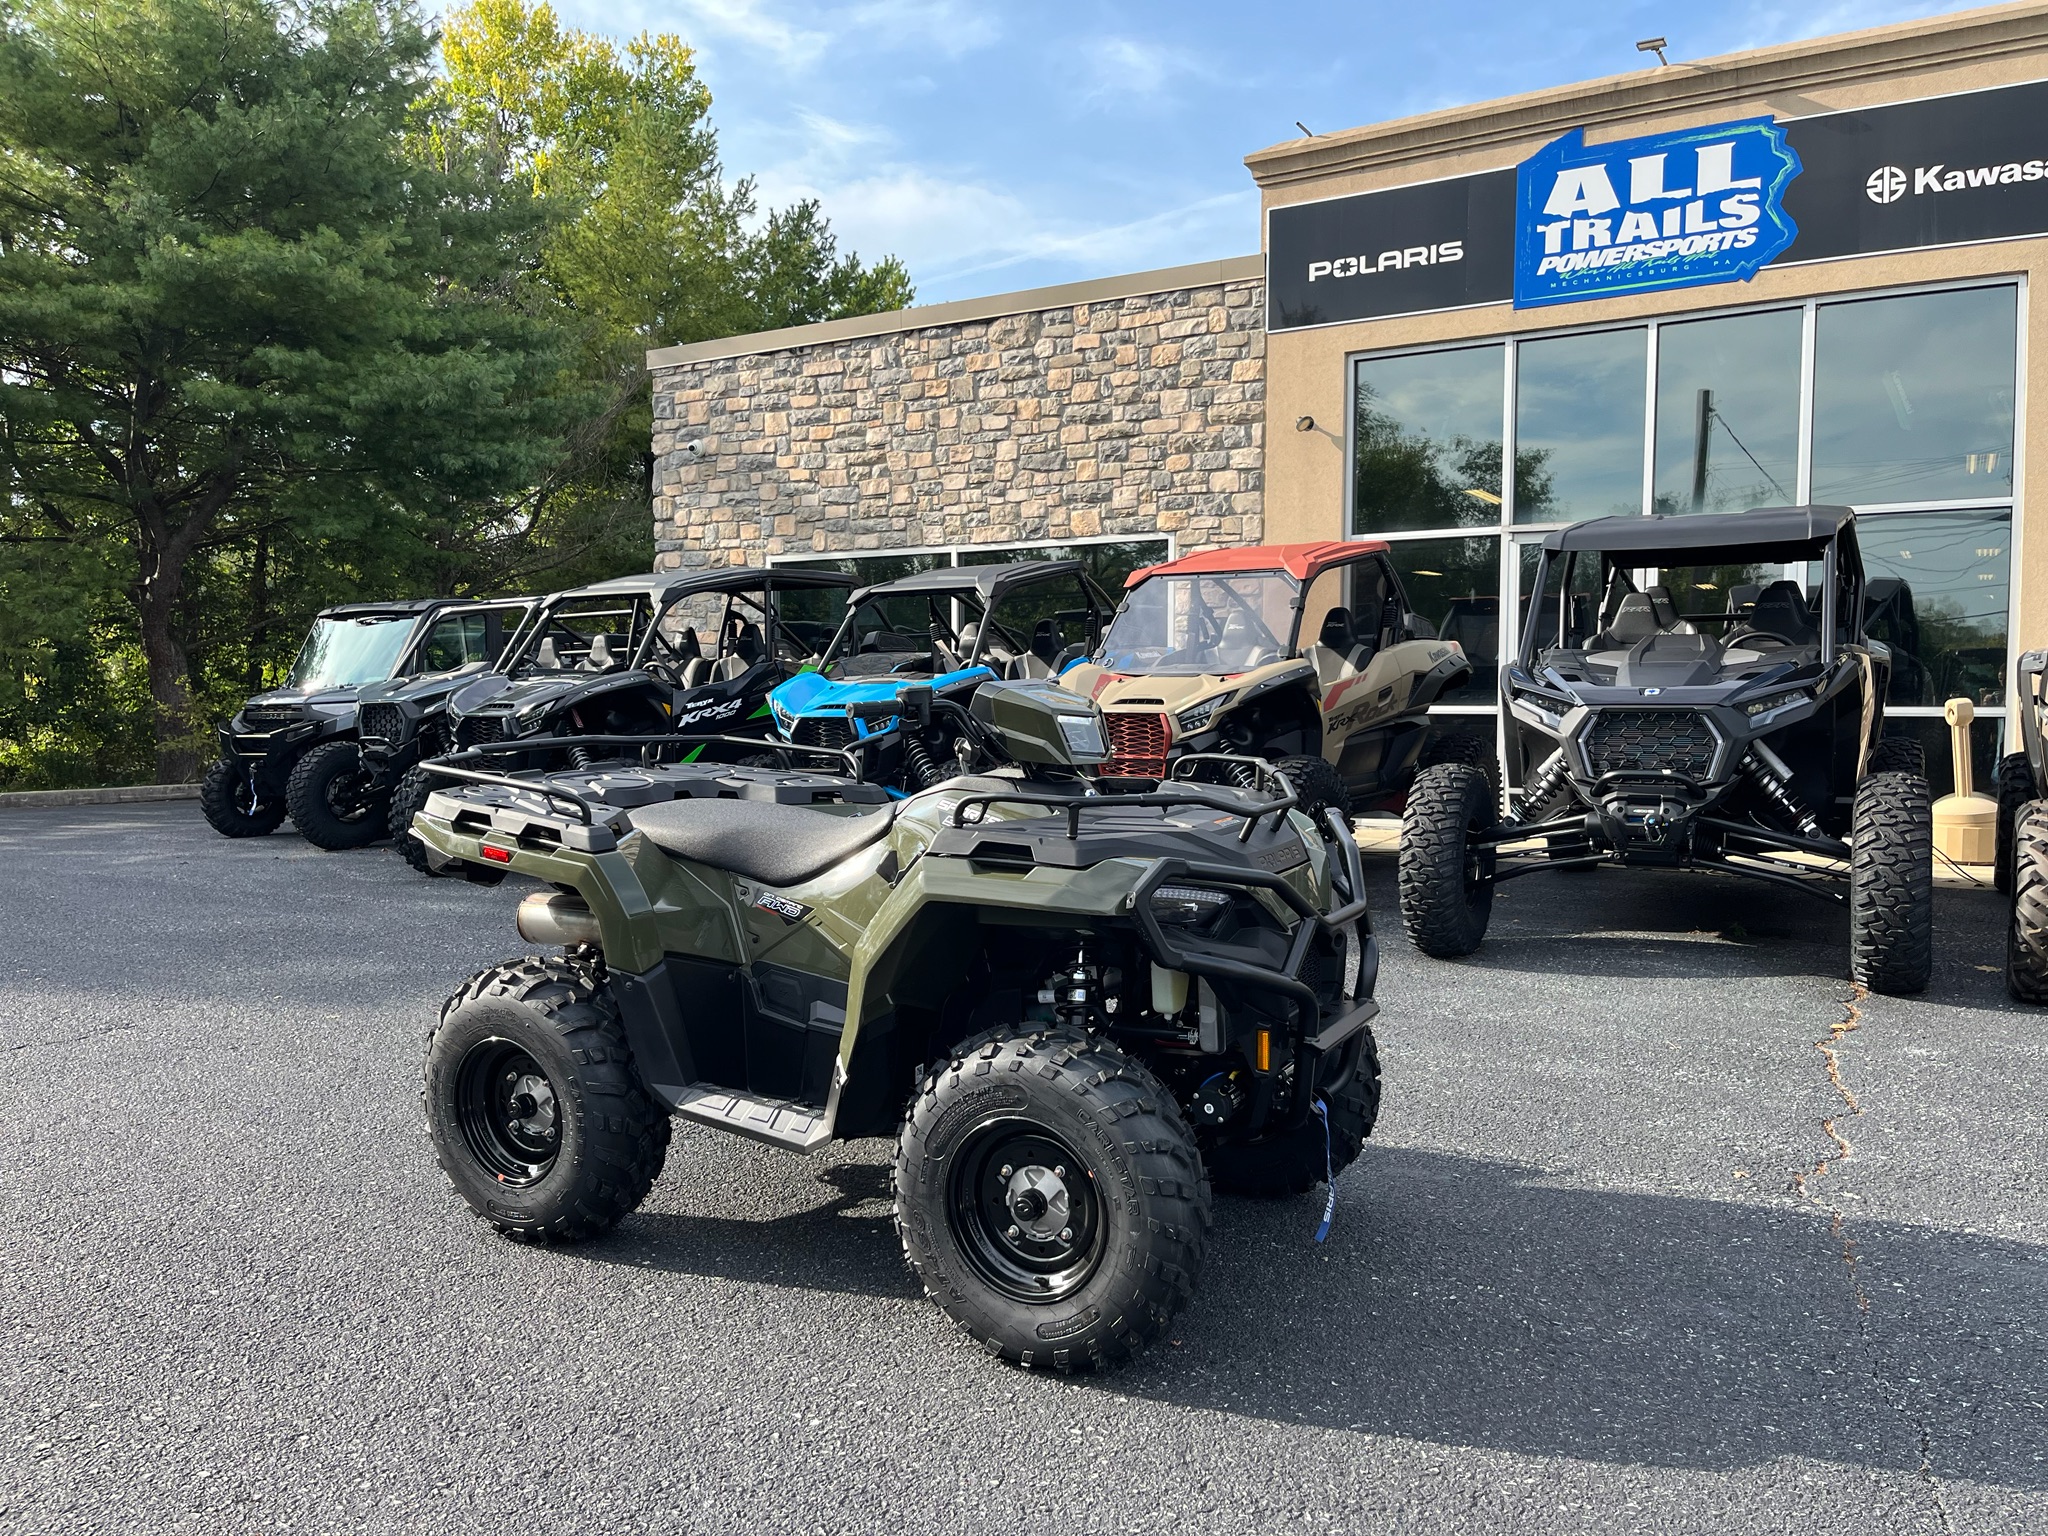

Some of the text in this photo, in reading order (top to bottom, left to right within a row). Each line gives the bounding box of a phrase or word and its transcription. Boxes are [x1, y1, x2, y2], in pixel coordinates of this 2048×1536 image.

[1543, 142, 1762, 218] ALL
[1914, 160, 2048, 195] Kawas
[1537, 193, 1761, 254] TRAILS
[1308, 240, 1464, 282] POLARIS
[1536, 227, 1759, 276] POWERSPORTS
[1713, 259, 1731, 267] PA
[715, 710, 737, 720] 1000
[757, 896, 801, 917] AWD
